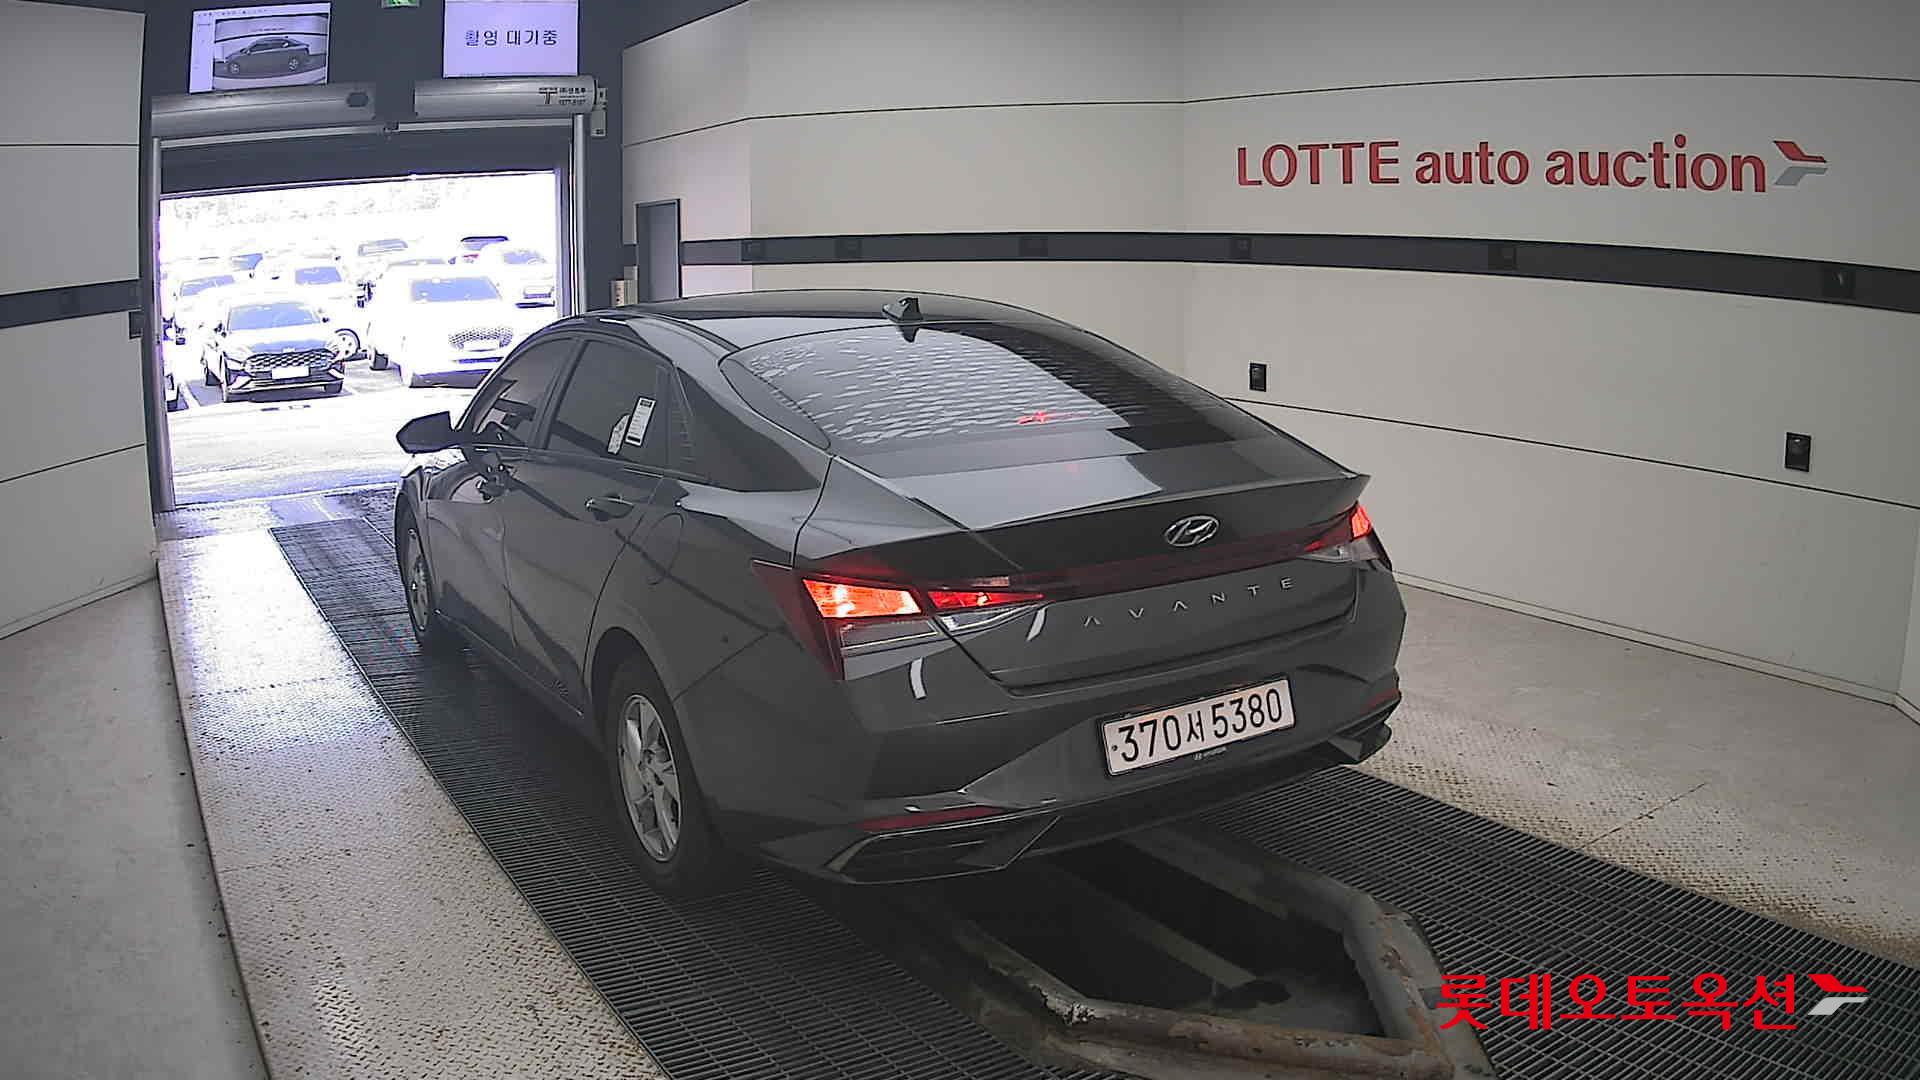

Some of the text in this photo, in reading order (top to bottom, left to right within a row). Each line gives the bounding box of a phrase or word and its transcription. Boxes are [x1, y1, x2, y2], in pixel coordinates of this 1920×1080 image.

[506, 29, 558, 46] 대기중
[1237, 133, 1767, 193] LOTTE auto auction
[1083, 577, 1294, 628] AVANTE
